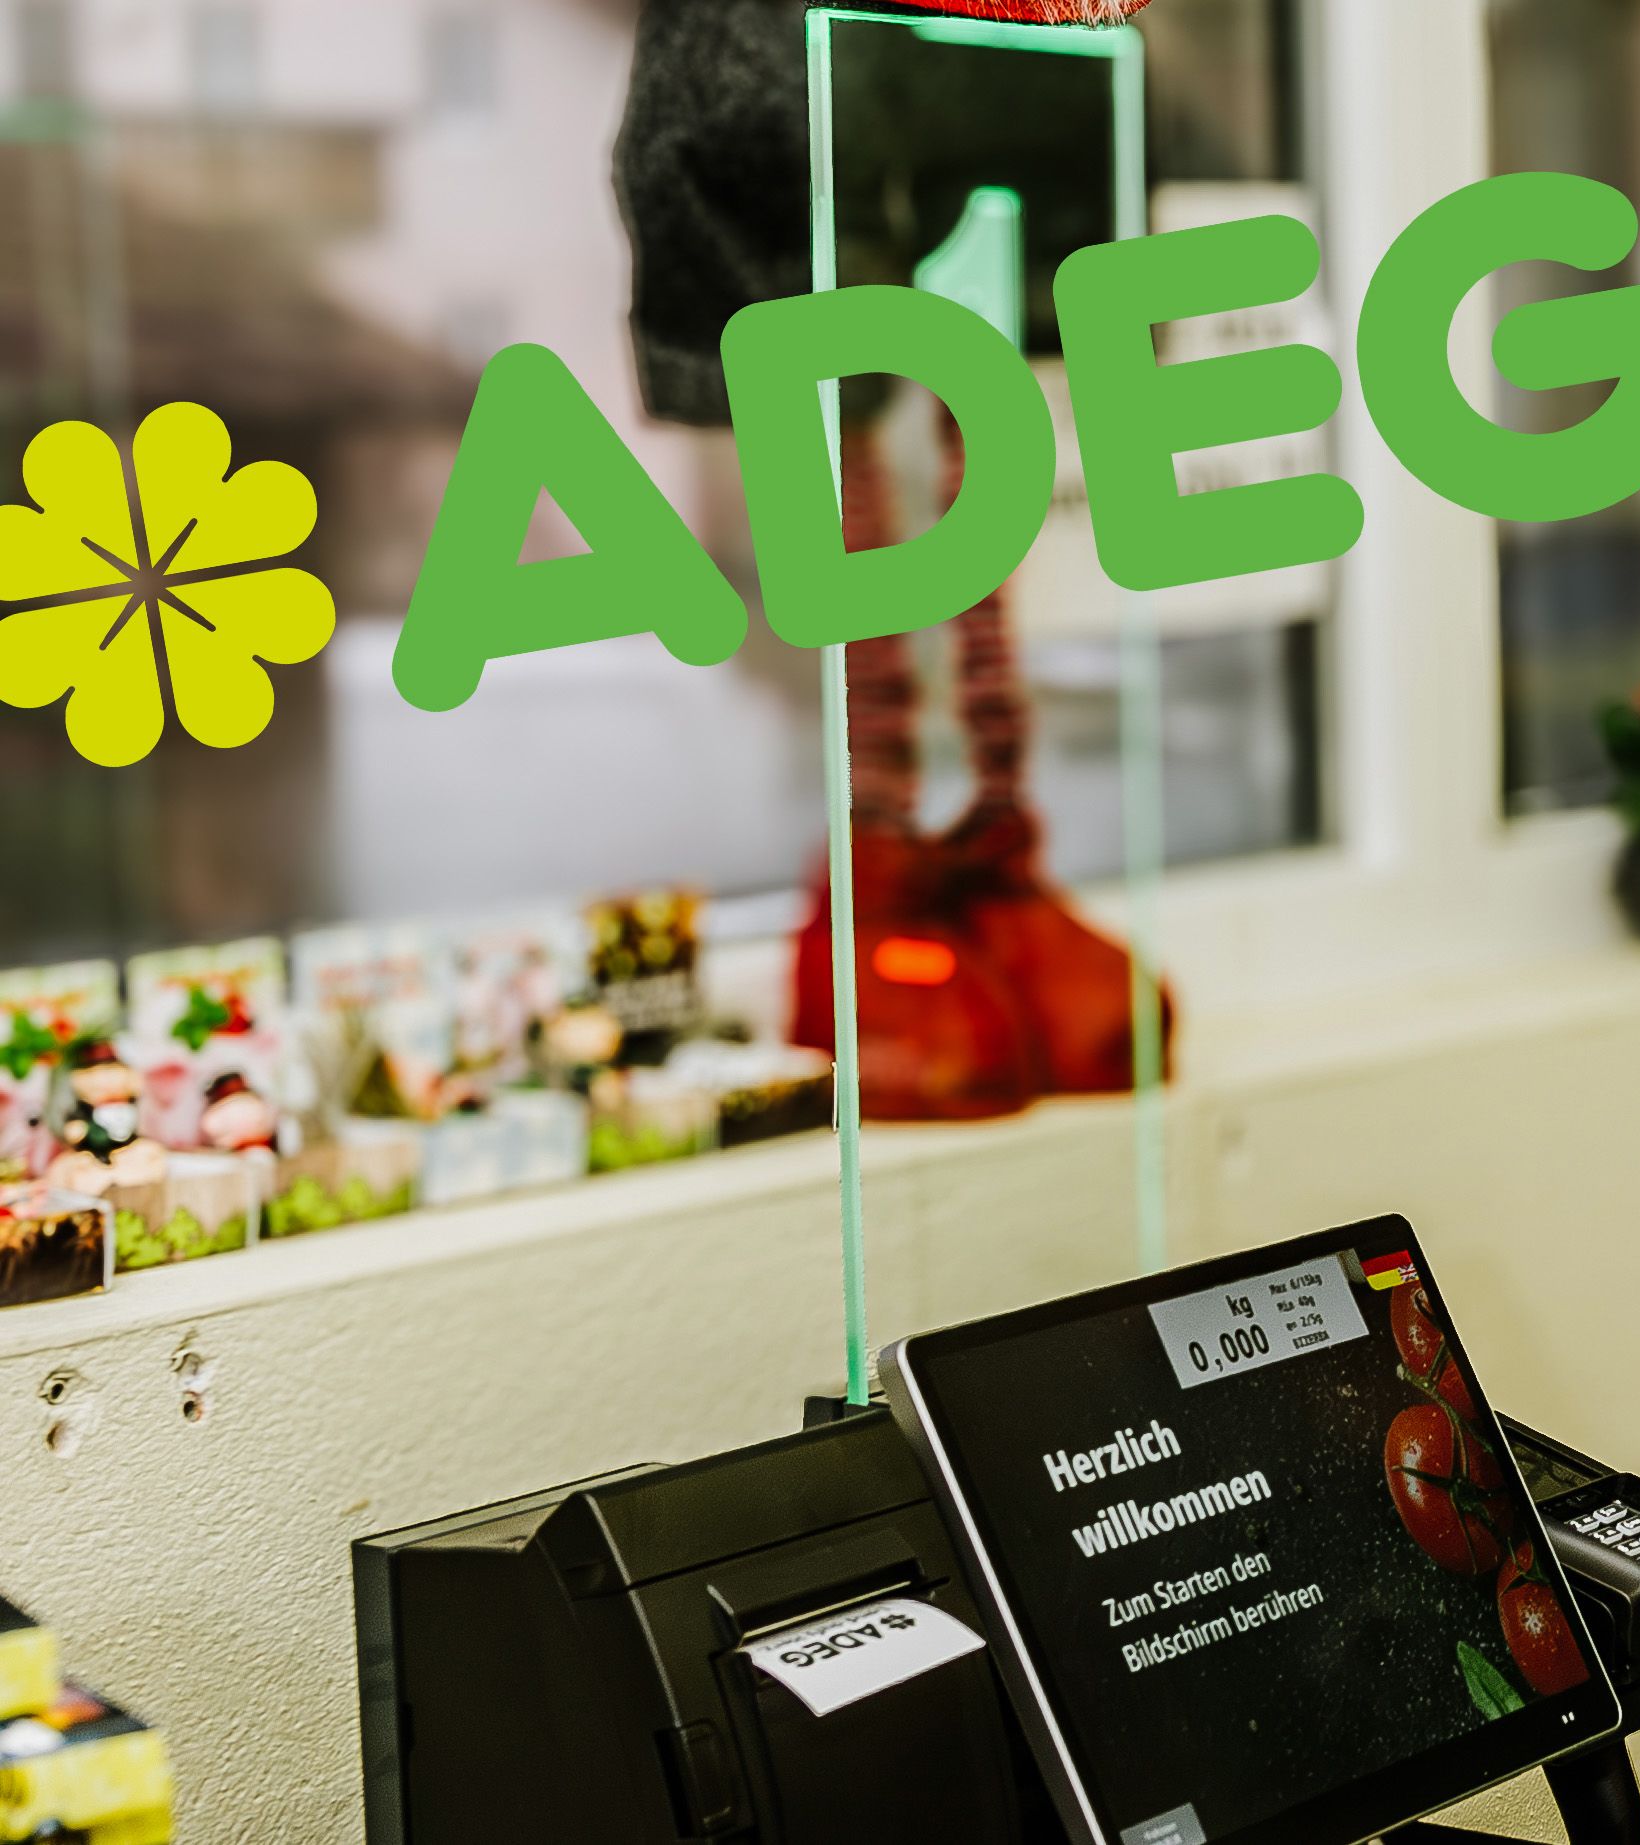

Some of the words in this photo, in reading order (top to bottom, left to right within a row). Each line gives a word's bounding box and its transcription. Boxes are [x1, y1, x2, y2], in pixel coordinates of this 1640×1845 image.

[1225, 1295, 1255, 1318] kg
[1188, 1324, 1270, 1372] 0,000
[1043, 1419, 1182, 1493] Herzlich
[1071, 1470, 1272, 1558] willkommen
[1101, 1592, 1156, 1628] Zum
[1153, 1564, 1232, 1610] Starten
[1231, 1552, 1272, 1583] den
[779, 1622, 883, 1668] ADEG
[1121, 1615, 1233, 1673] Bildschirm
[1230, 1583, 1324, 1633] berühren
